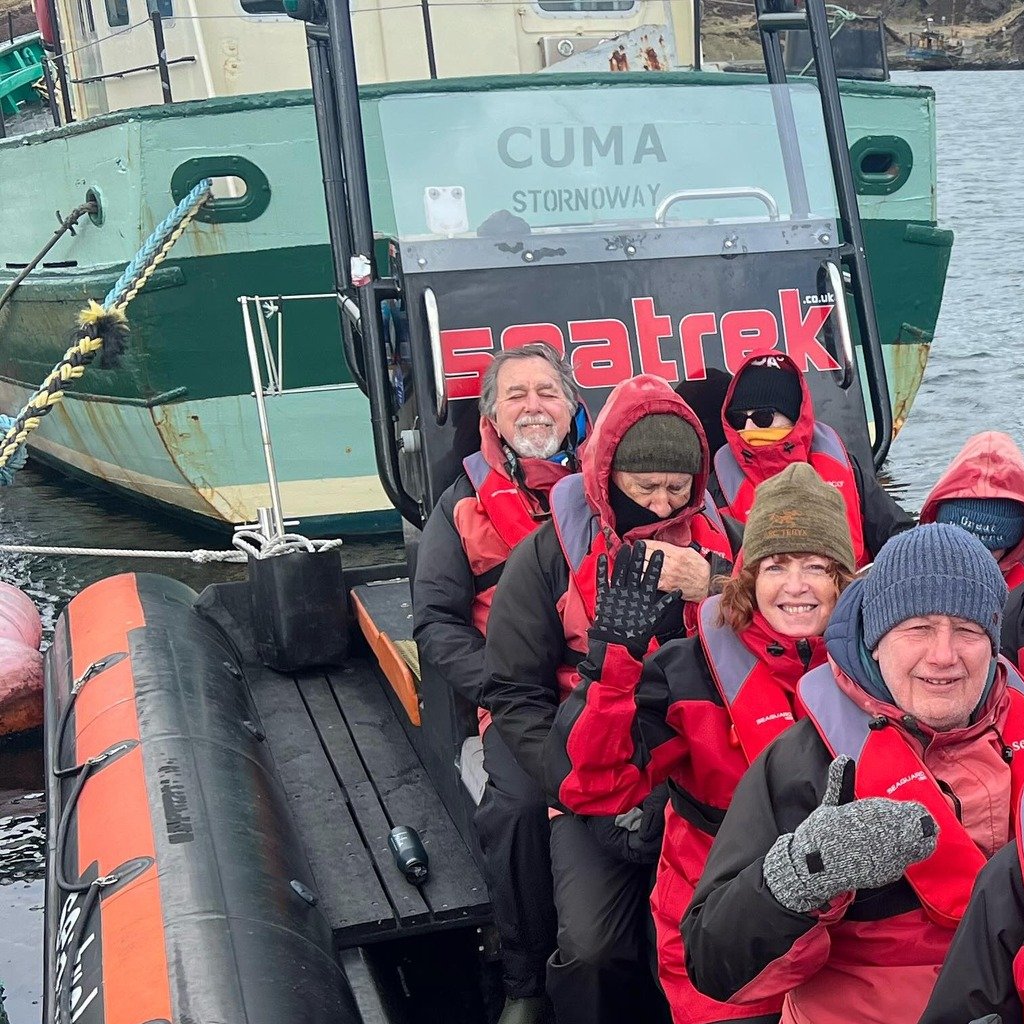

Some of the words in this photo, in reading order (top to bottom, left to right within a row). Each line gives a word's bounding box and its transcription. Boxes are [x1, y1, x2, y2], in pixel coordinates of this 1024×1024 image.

[497, 123, 667, 169] CUMA
[512, 183, 660, 213] STORNOWAY
[441, 289, 841, 400] seatrek
